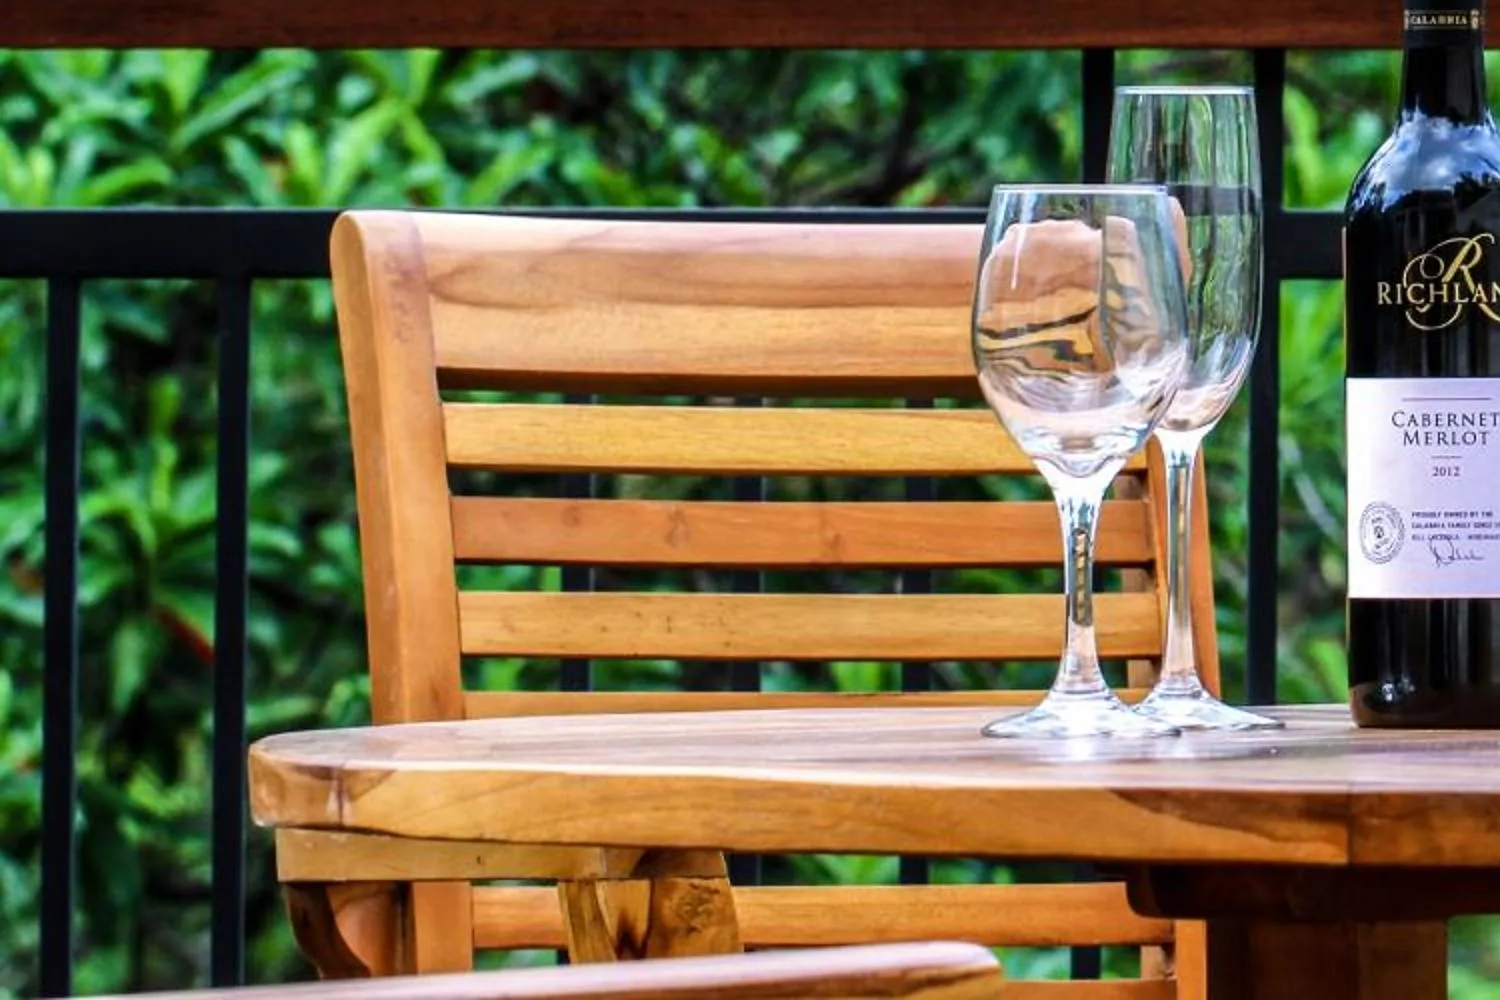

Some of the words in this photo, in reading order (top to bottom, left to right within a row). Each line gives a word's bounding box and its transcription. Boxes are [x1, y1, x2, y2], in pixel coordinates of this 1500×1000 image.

[1391, 409, 1500, 428] CABERNET
[1402, 430, 1490, 447] MERLOT
[1432, 466, 1460, 477] 2012
